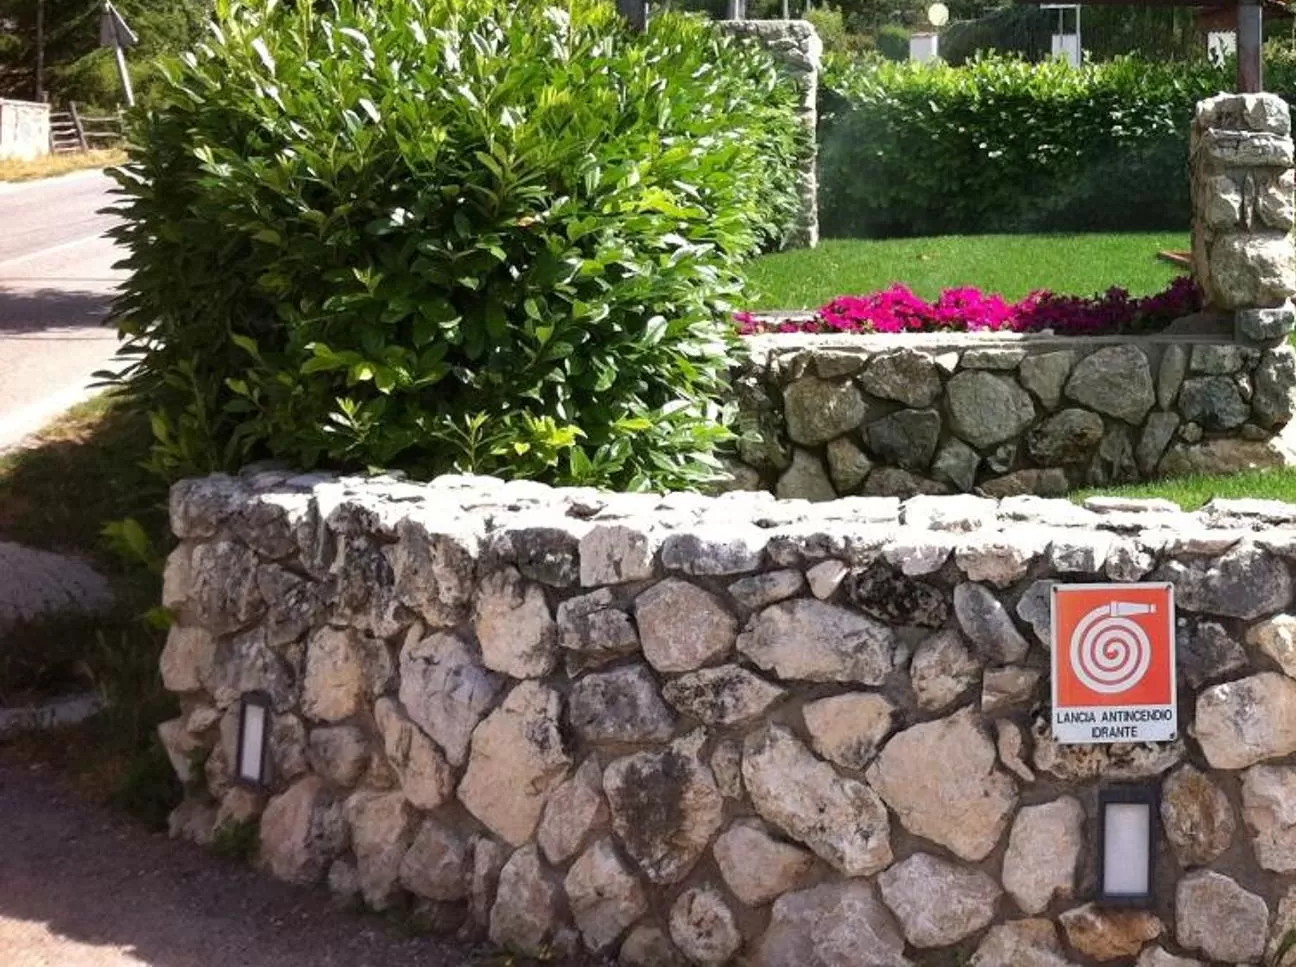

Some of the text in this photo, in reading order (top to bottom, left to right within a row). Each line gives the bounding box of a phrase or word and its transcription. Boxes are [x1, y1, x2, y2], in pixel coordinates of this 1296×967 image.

[1056, 709, 1173, 724] LANCIA ANTINCENDIO
[1091, 726, 1138, 738] IDRANTE
